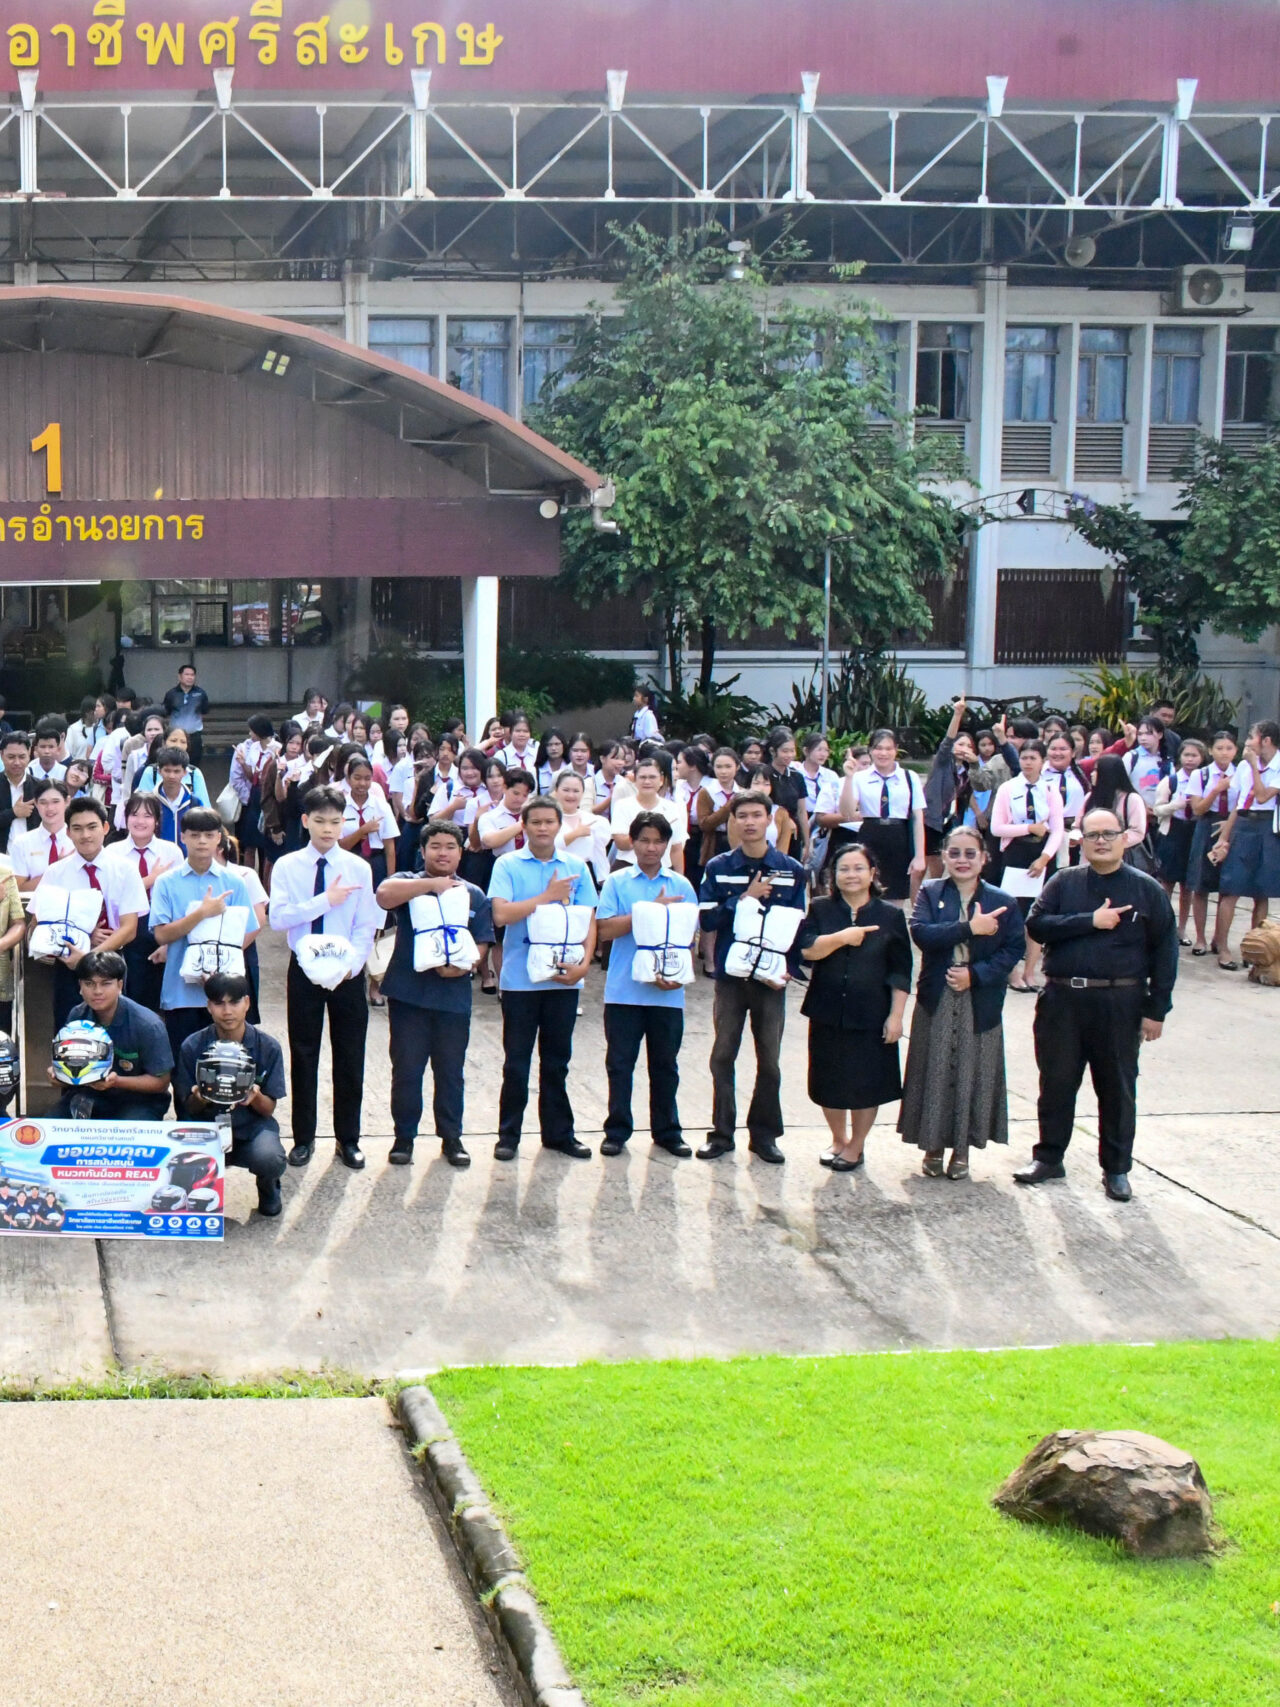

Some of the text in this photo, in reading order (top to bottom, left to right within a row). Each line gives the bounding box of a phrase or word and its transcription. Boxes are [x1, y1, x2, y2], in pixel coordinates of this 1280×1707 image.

[31, 423, 62, 492] 1
[57, 1145, 156, 1160] ขอขอบคุณ
[125, 1170, 155, 1179] REAL
